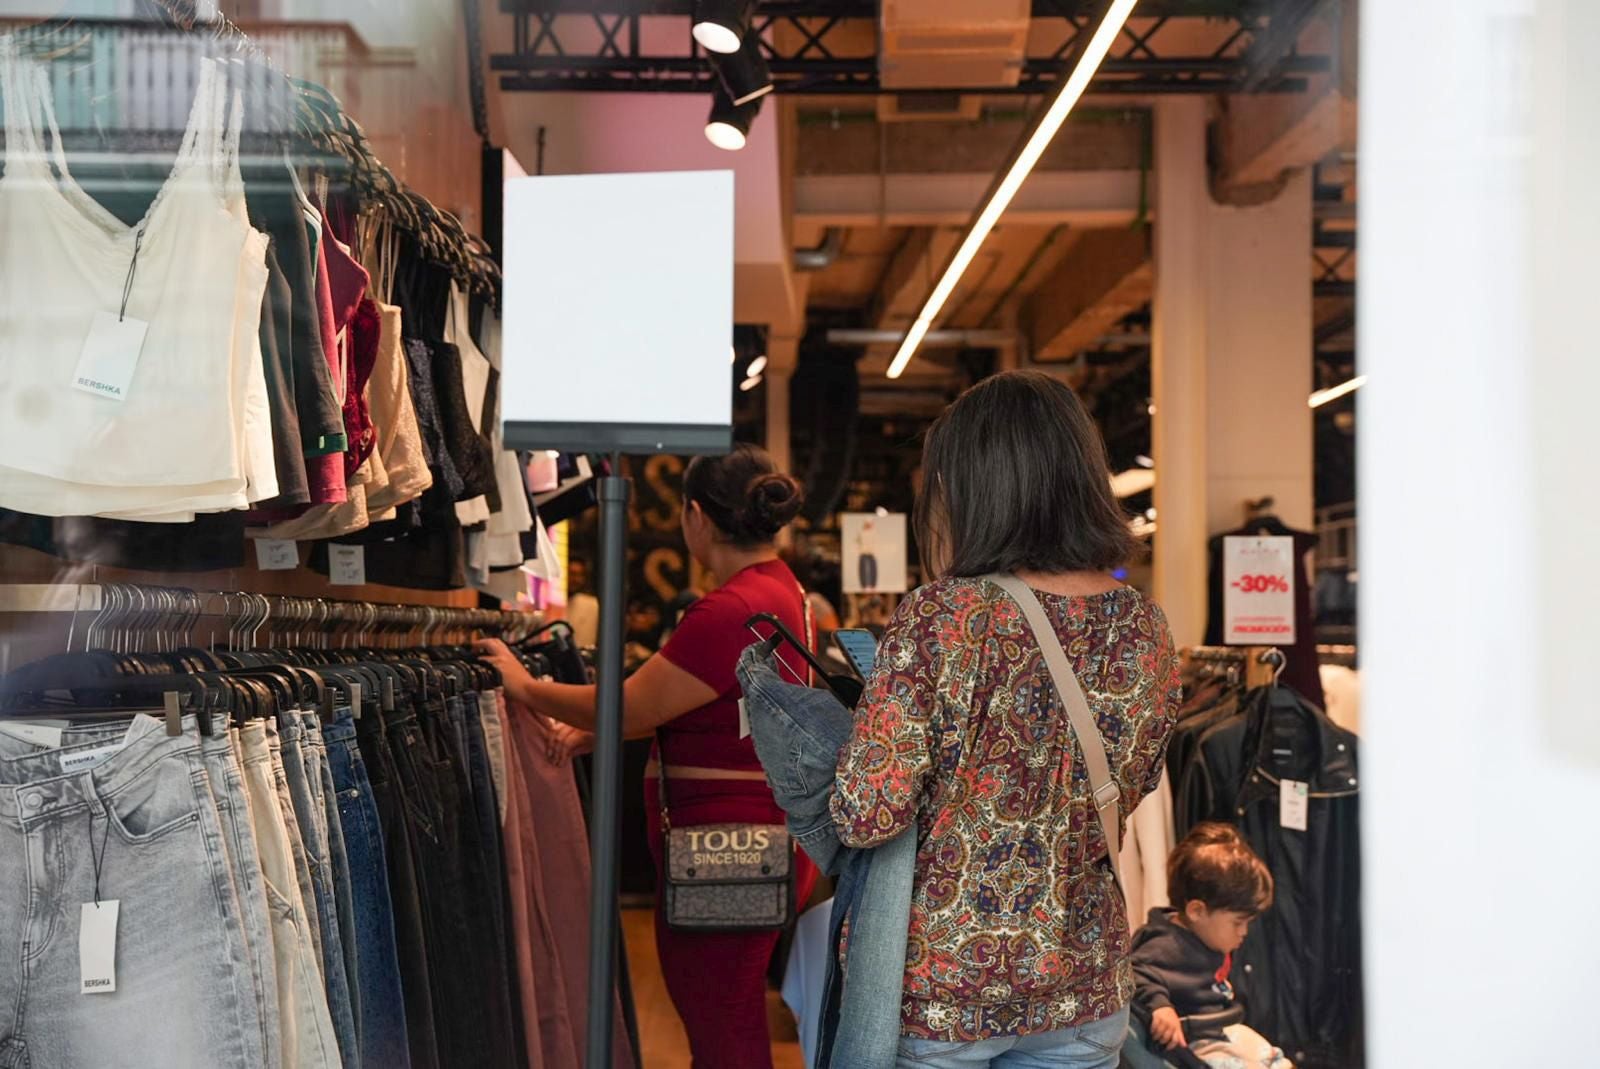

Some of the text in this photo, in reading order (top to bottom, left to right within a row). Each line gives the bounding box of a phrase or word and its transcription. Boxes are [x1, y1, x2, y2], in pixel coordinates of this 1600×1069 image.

[78, 377, 121, 395] BERSHKA
[1232, 574, 1289, 593] -30%
[64, 755, 96, 767] BERSHKA
[686, 829, 770, 852] TOUS
[84, 977, 111, 988] BERSHKA
